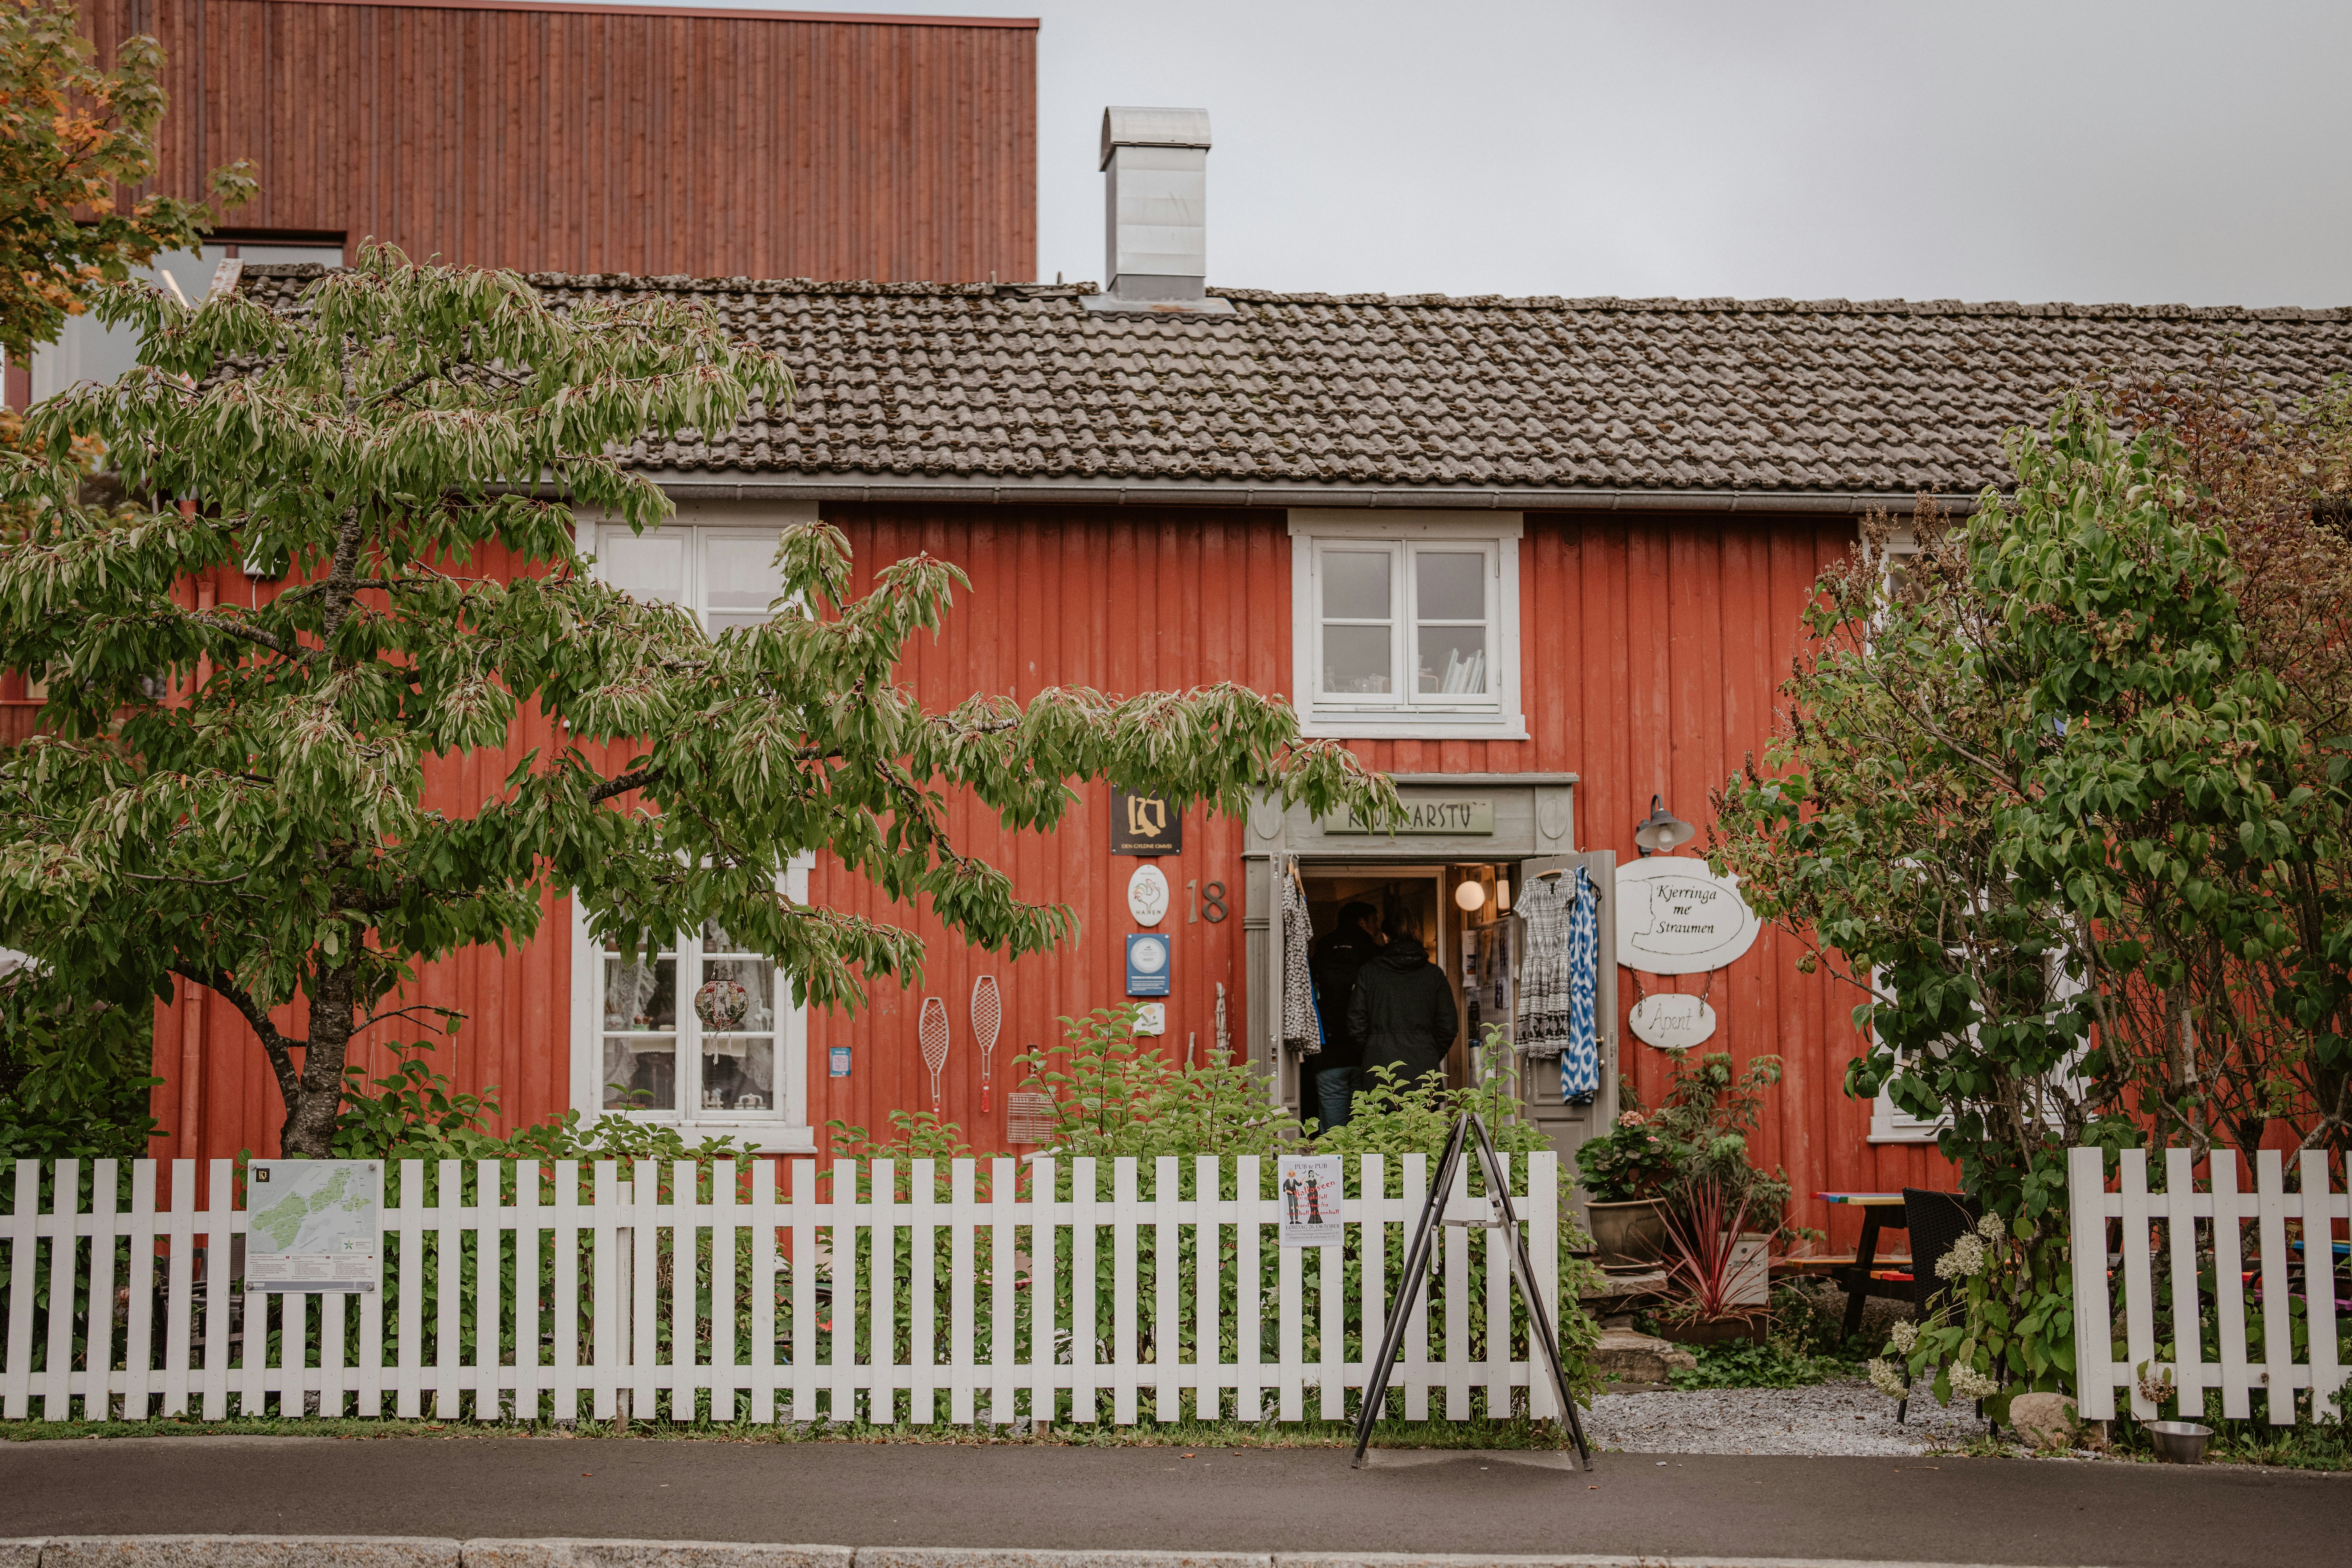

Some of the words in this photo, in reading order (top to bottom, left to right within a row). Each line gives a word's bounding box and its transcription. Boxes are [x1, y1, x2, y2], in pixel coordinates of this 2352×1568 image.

[1187, 879, 1228, 924] 18
[1657, 885, 1717, 904] Kjerringa
[1656, 921, 1714, 934] Straumen
[1649, 1003, 1692, 1038] Åpent
[1294, 1181, 1336, 1197] Halloween
